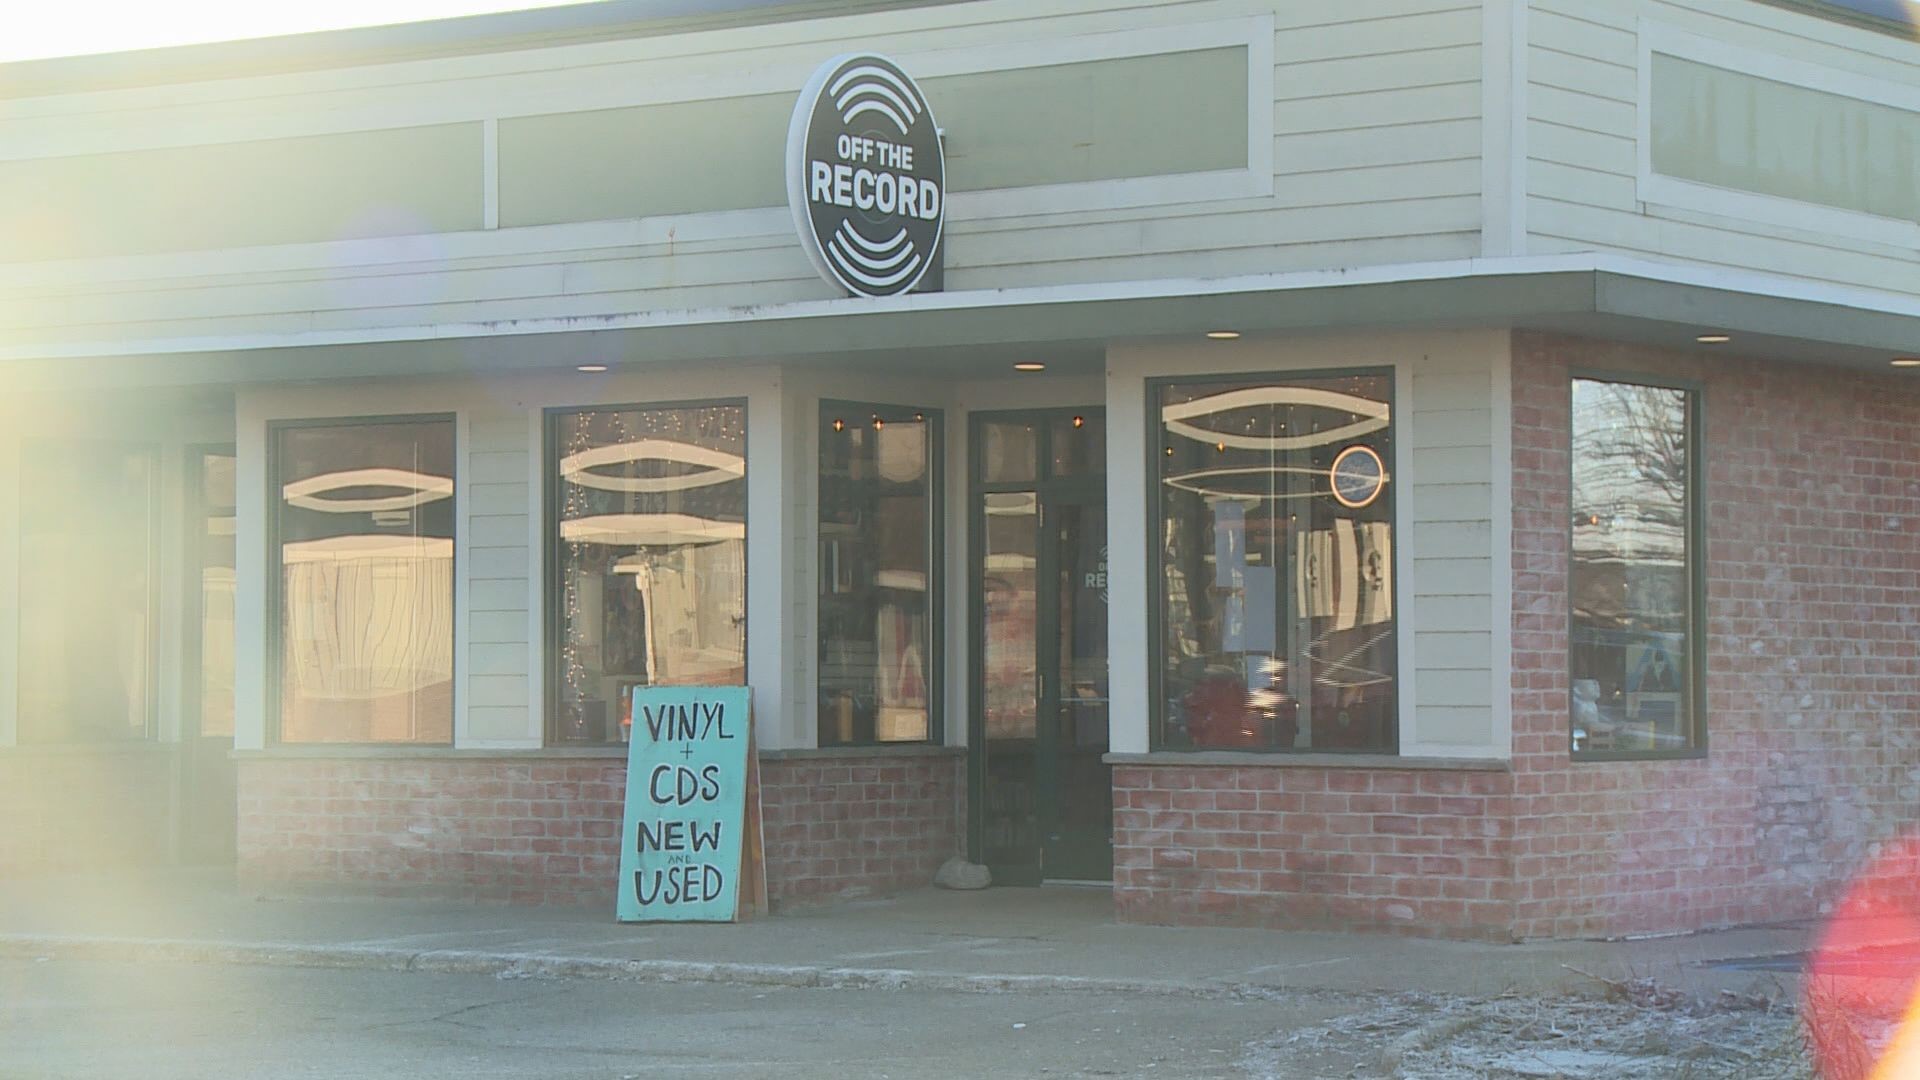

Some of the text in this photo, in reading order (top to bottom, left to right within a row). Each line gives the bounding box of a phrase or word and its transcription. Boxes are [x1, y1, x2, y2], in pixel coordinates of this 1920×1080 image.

[838, 134, 913, 171] OFF THE
[811, 160, 939, 220] RECORD
[643, 702, 734, 742] VINYL
[679, 743, 693, 760] +
[649, 764, 719, 805] CDS
[636, 820, 721, 853] NEW
[668, 855, 691, 864] AND
[634, 864, 723, 906] USED
